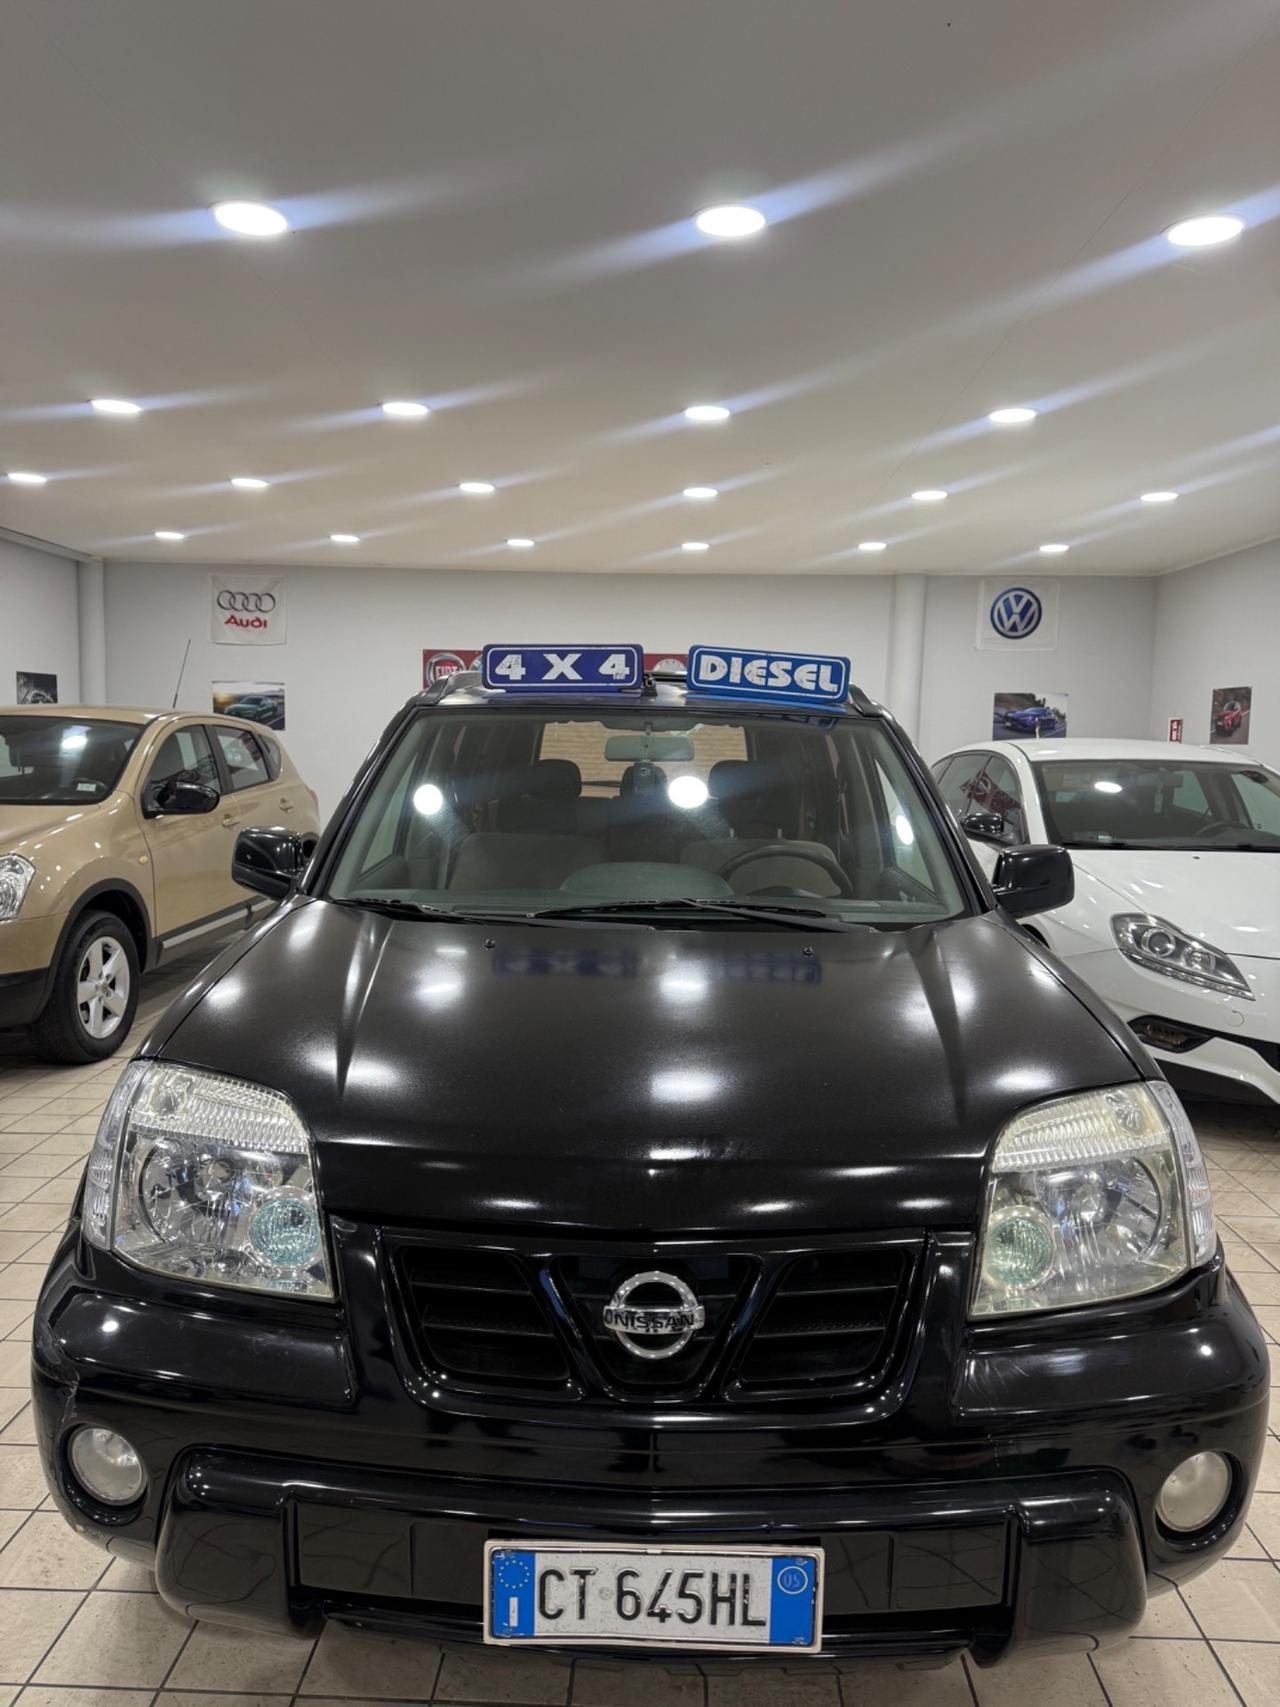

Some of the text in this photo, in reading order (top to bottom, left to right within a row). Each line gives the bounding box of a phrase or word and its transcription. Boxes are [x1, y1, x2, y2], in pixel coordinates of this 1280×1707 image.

[225, 614, 268, 629] Audi
[699, 654, 839, 693] DIESEL
[614, 1312, 695, 1330] NISSAN
[538, 1568, 767, 1627] CT 645HL
